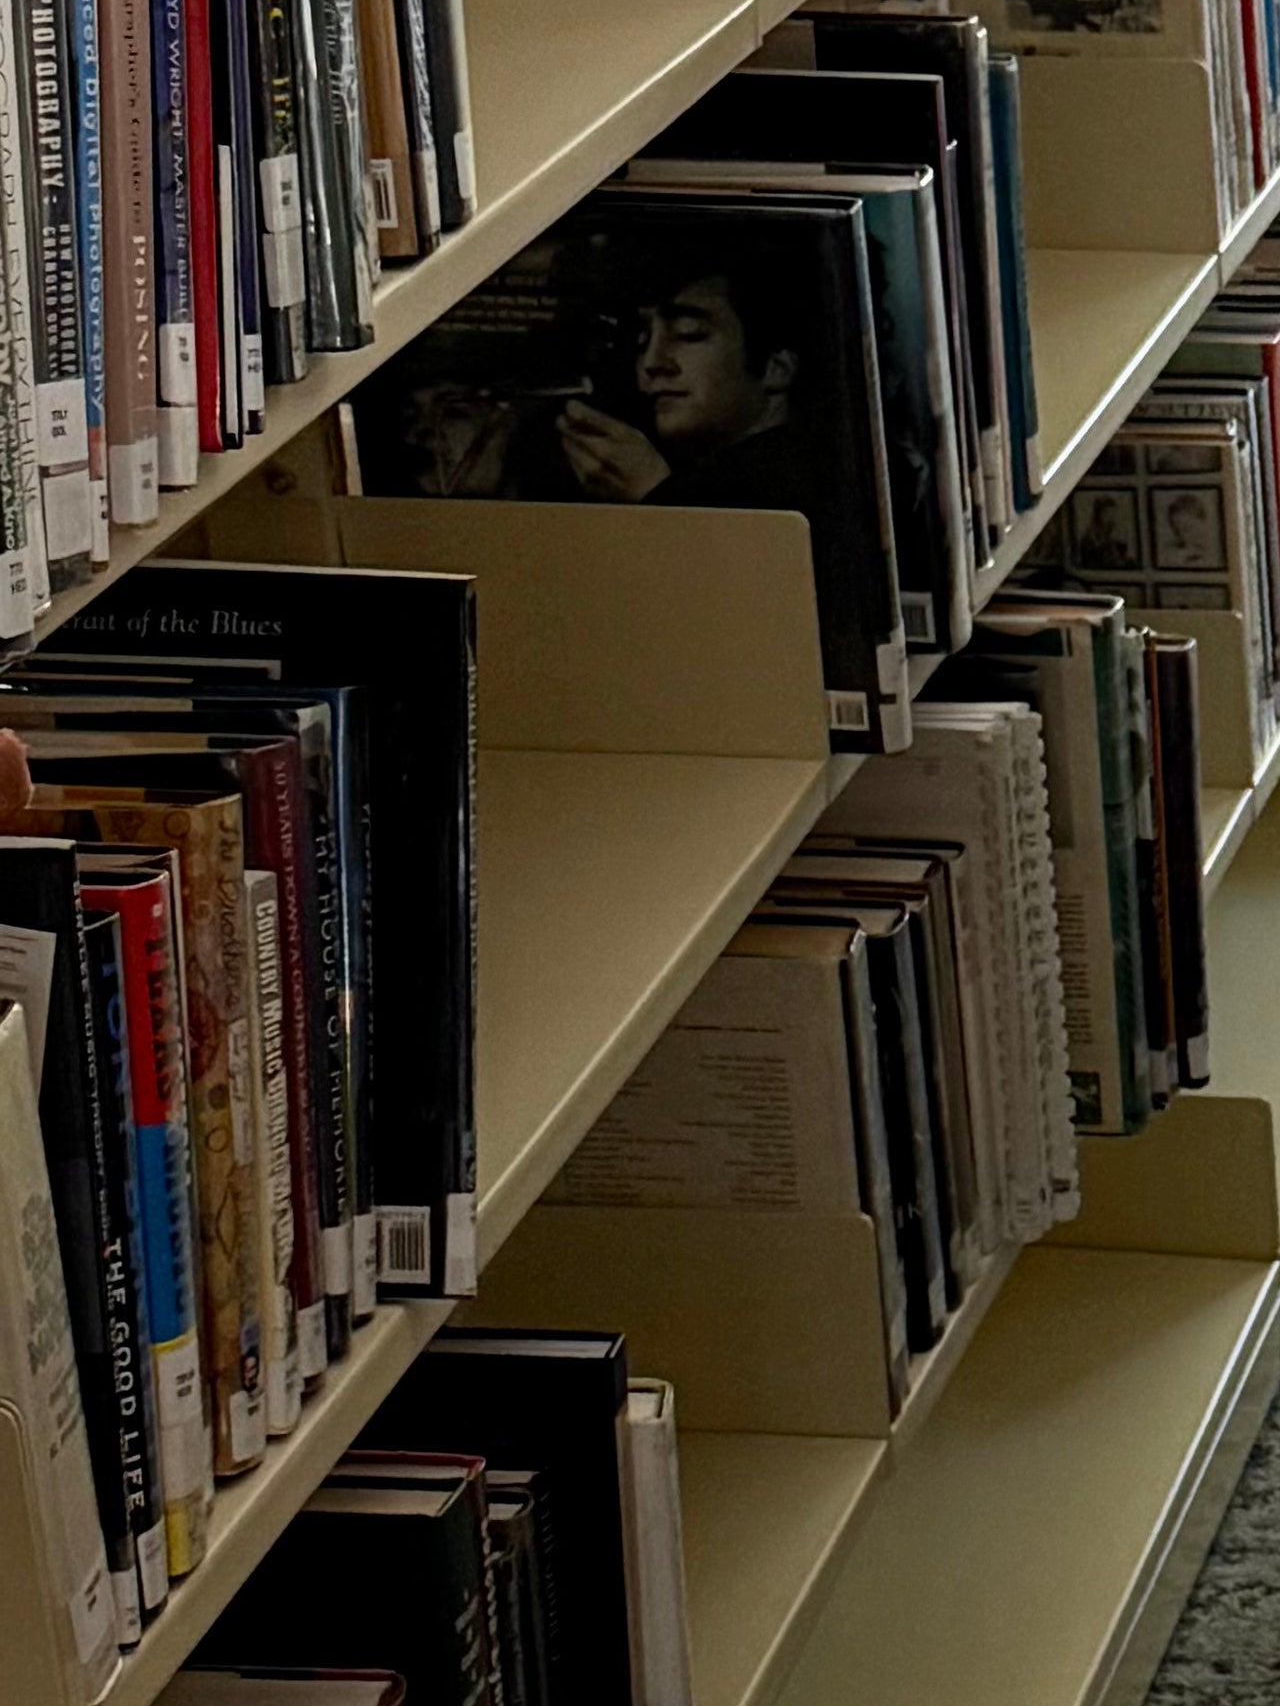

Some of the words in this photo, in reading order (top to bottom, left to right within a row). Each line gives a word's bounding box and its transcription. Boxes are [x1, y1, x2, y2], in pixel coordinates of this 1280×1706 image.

[84, 76, 101, 189] Digital
[171, 153, 190, 249] MASTER
[86, 203, 107, 412] Photography
[131, 234, 150, 381] POSING
[126, 609, 152, 638] of
[159, 609, 200, 635] the
[210, 609, 283, 636] Blues
[254, 899, 283, 996] COUNTRY
[318, 893, 339, 1002] HOUSE
[261, 1001, 285, 1076] MUSIC
[103, 1237, 126, 1306] THE
[112, 1321, 137, 1417] GOOD
[120, 1431, 146, 1510] LIFE
